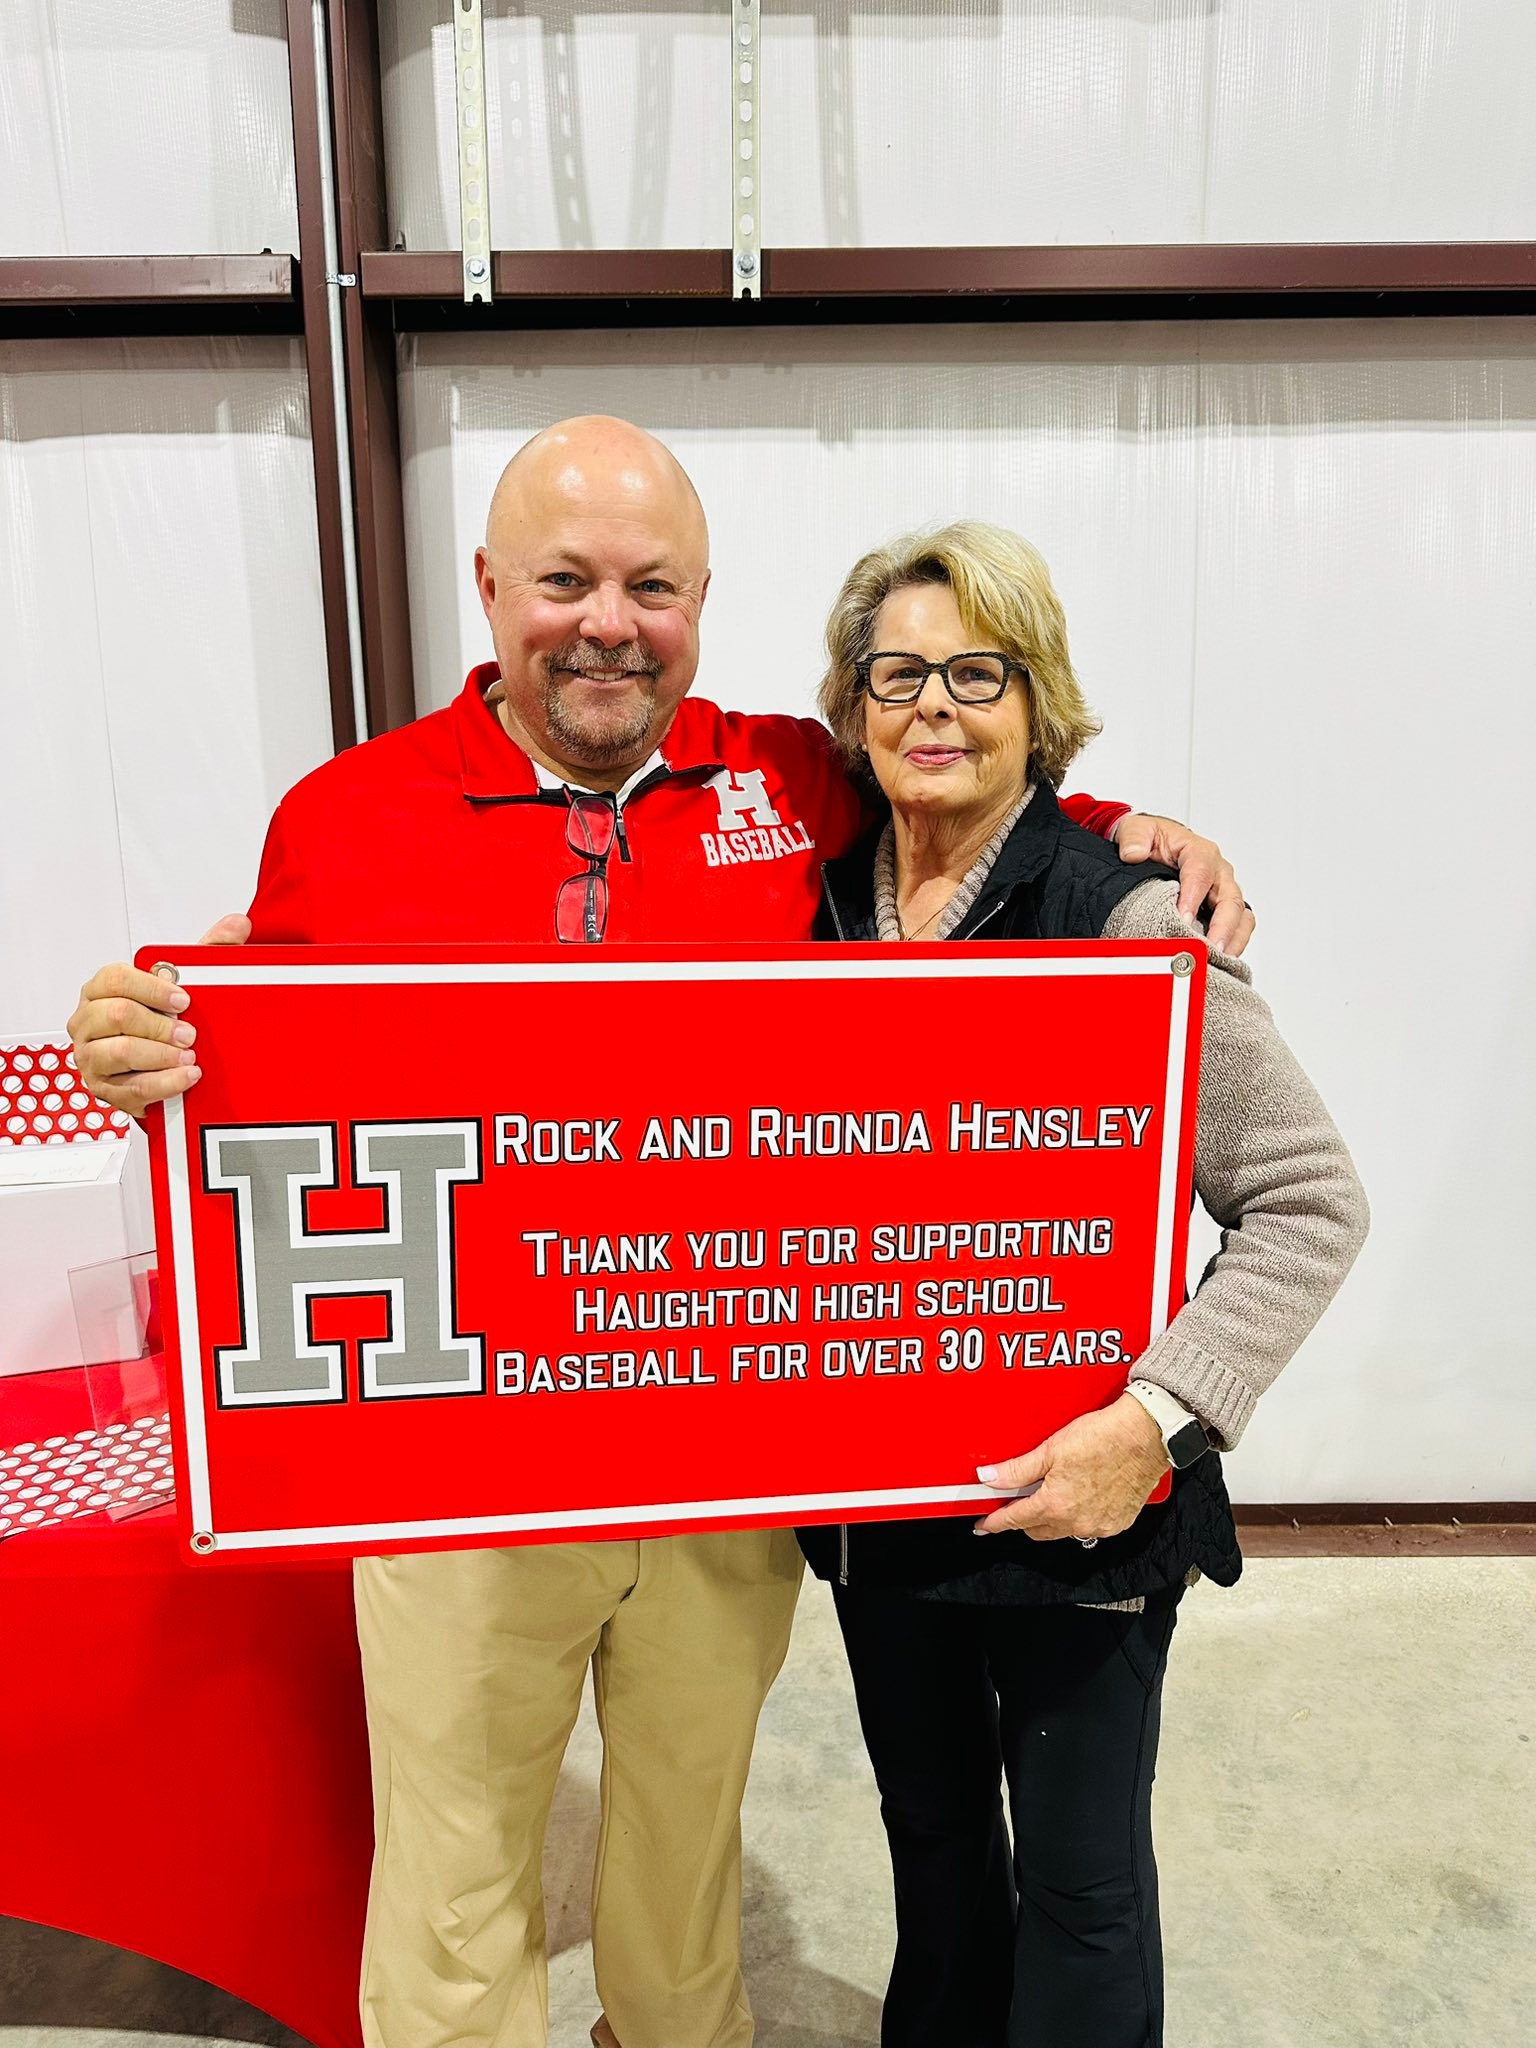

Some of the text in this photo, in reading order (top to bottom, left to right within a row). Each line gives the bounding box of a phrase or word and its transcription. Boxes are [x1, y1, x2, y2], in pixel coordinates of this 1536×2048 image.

[701, 769, 782, 832] H
[700, 820, 816, 867] BASEBALL
[494, 1102, 1153, 1165] ROCK AND RHONDA HENSLEY
[201, 1117, 486, 1409] H
[521, 1218, 1112, 1277] THANK YOU FOR SUPPORTING
[574, 1276, 1064, 1334] HAUGHTON HIGH SCHOOL
[495, 1327, 1132, 1396] BASEBALL FOR OVER 30 YEARS.
